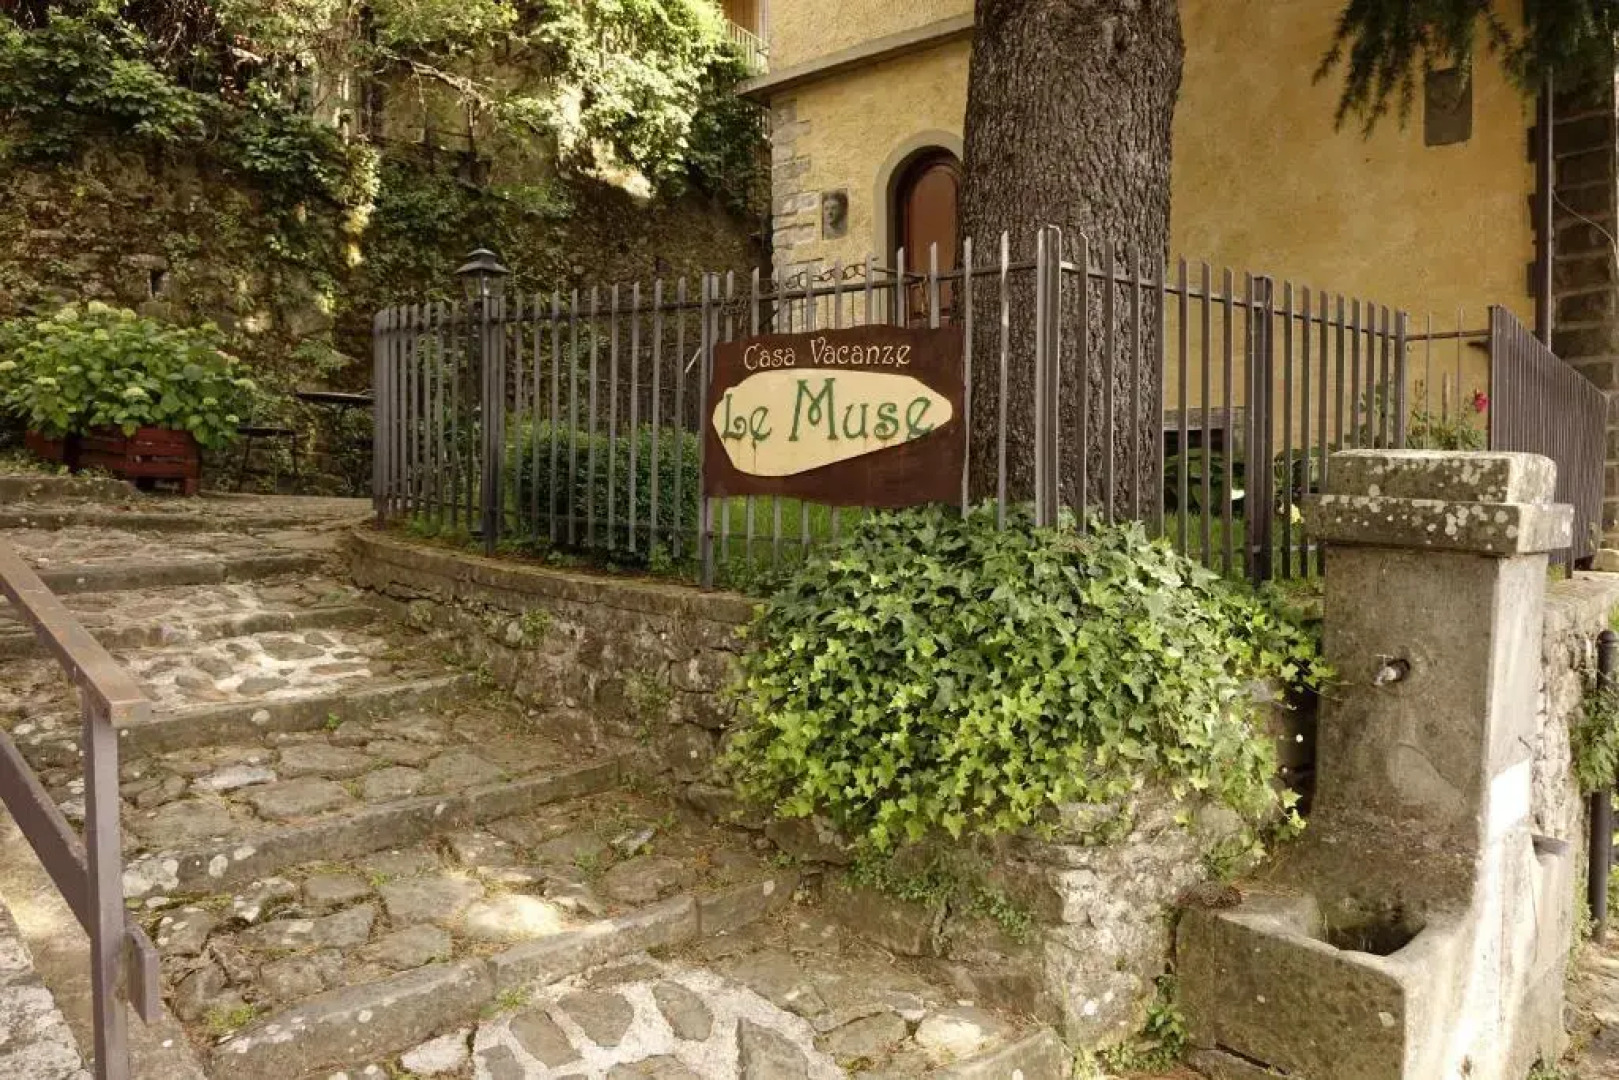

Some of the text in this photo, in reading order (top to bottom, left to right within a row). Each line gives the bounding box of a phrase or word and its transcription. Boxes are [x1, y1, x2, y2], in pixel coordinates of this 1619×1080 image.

[744, 336, 912, 370] Casa Vacanze
[721, 377, 935, 442] Le Muse
